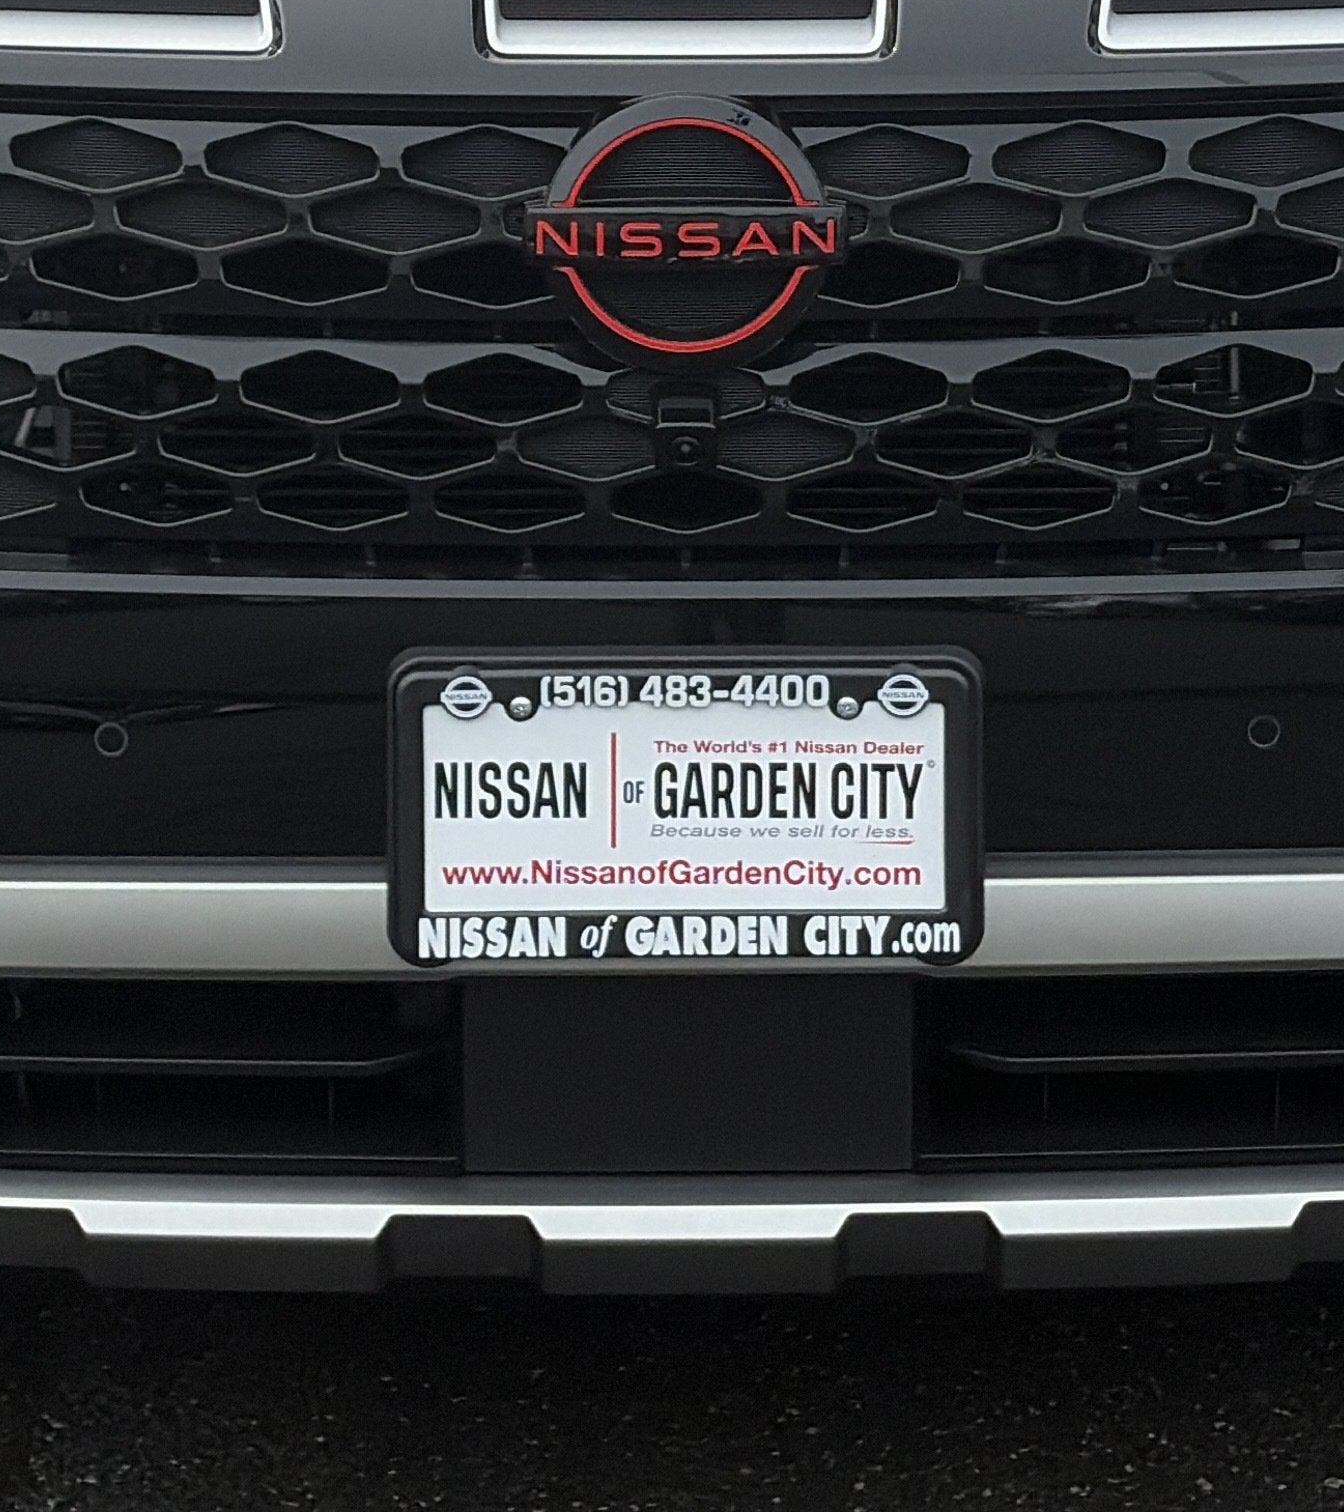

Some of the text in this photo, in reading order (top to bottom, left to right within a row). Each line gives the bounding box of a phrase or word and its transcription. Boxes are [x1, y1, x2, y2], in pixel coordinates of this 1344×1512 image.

[535, 219, 835, 257] NISSAN
[444, 692, 488, 701] NISSAN
[539, 674, 830, 708] (516) 483-4400
[881, 691, 926, 699] NISSAN
[653, 740, 925, 755] The World's #1 Nissan Dealer
[434, 761, 924, 820] NISSAN OF GARDEN CITY
[650, 823, 915, 839] Because we sell for less.
[442, 859, 922, 890] www.NissanofGardenCity.com
[417, 914, 962, 959] NISSAN of GARDEN CITY.com
